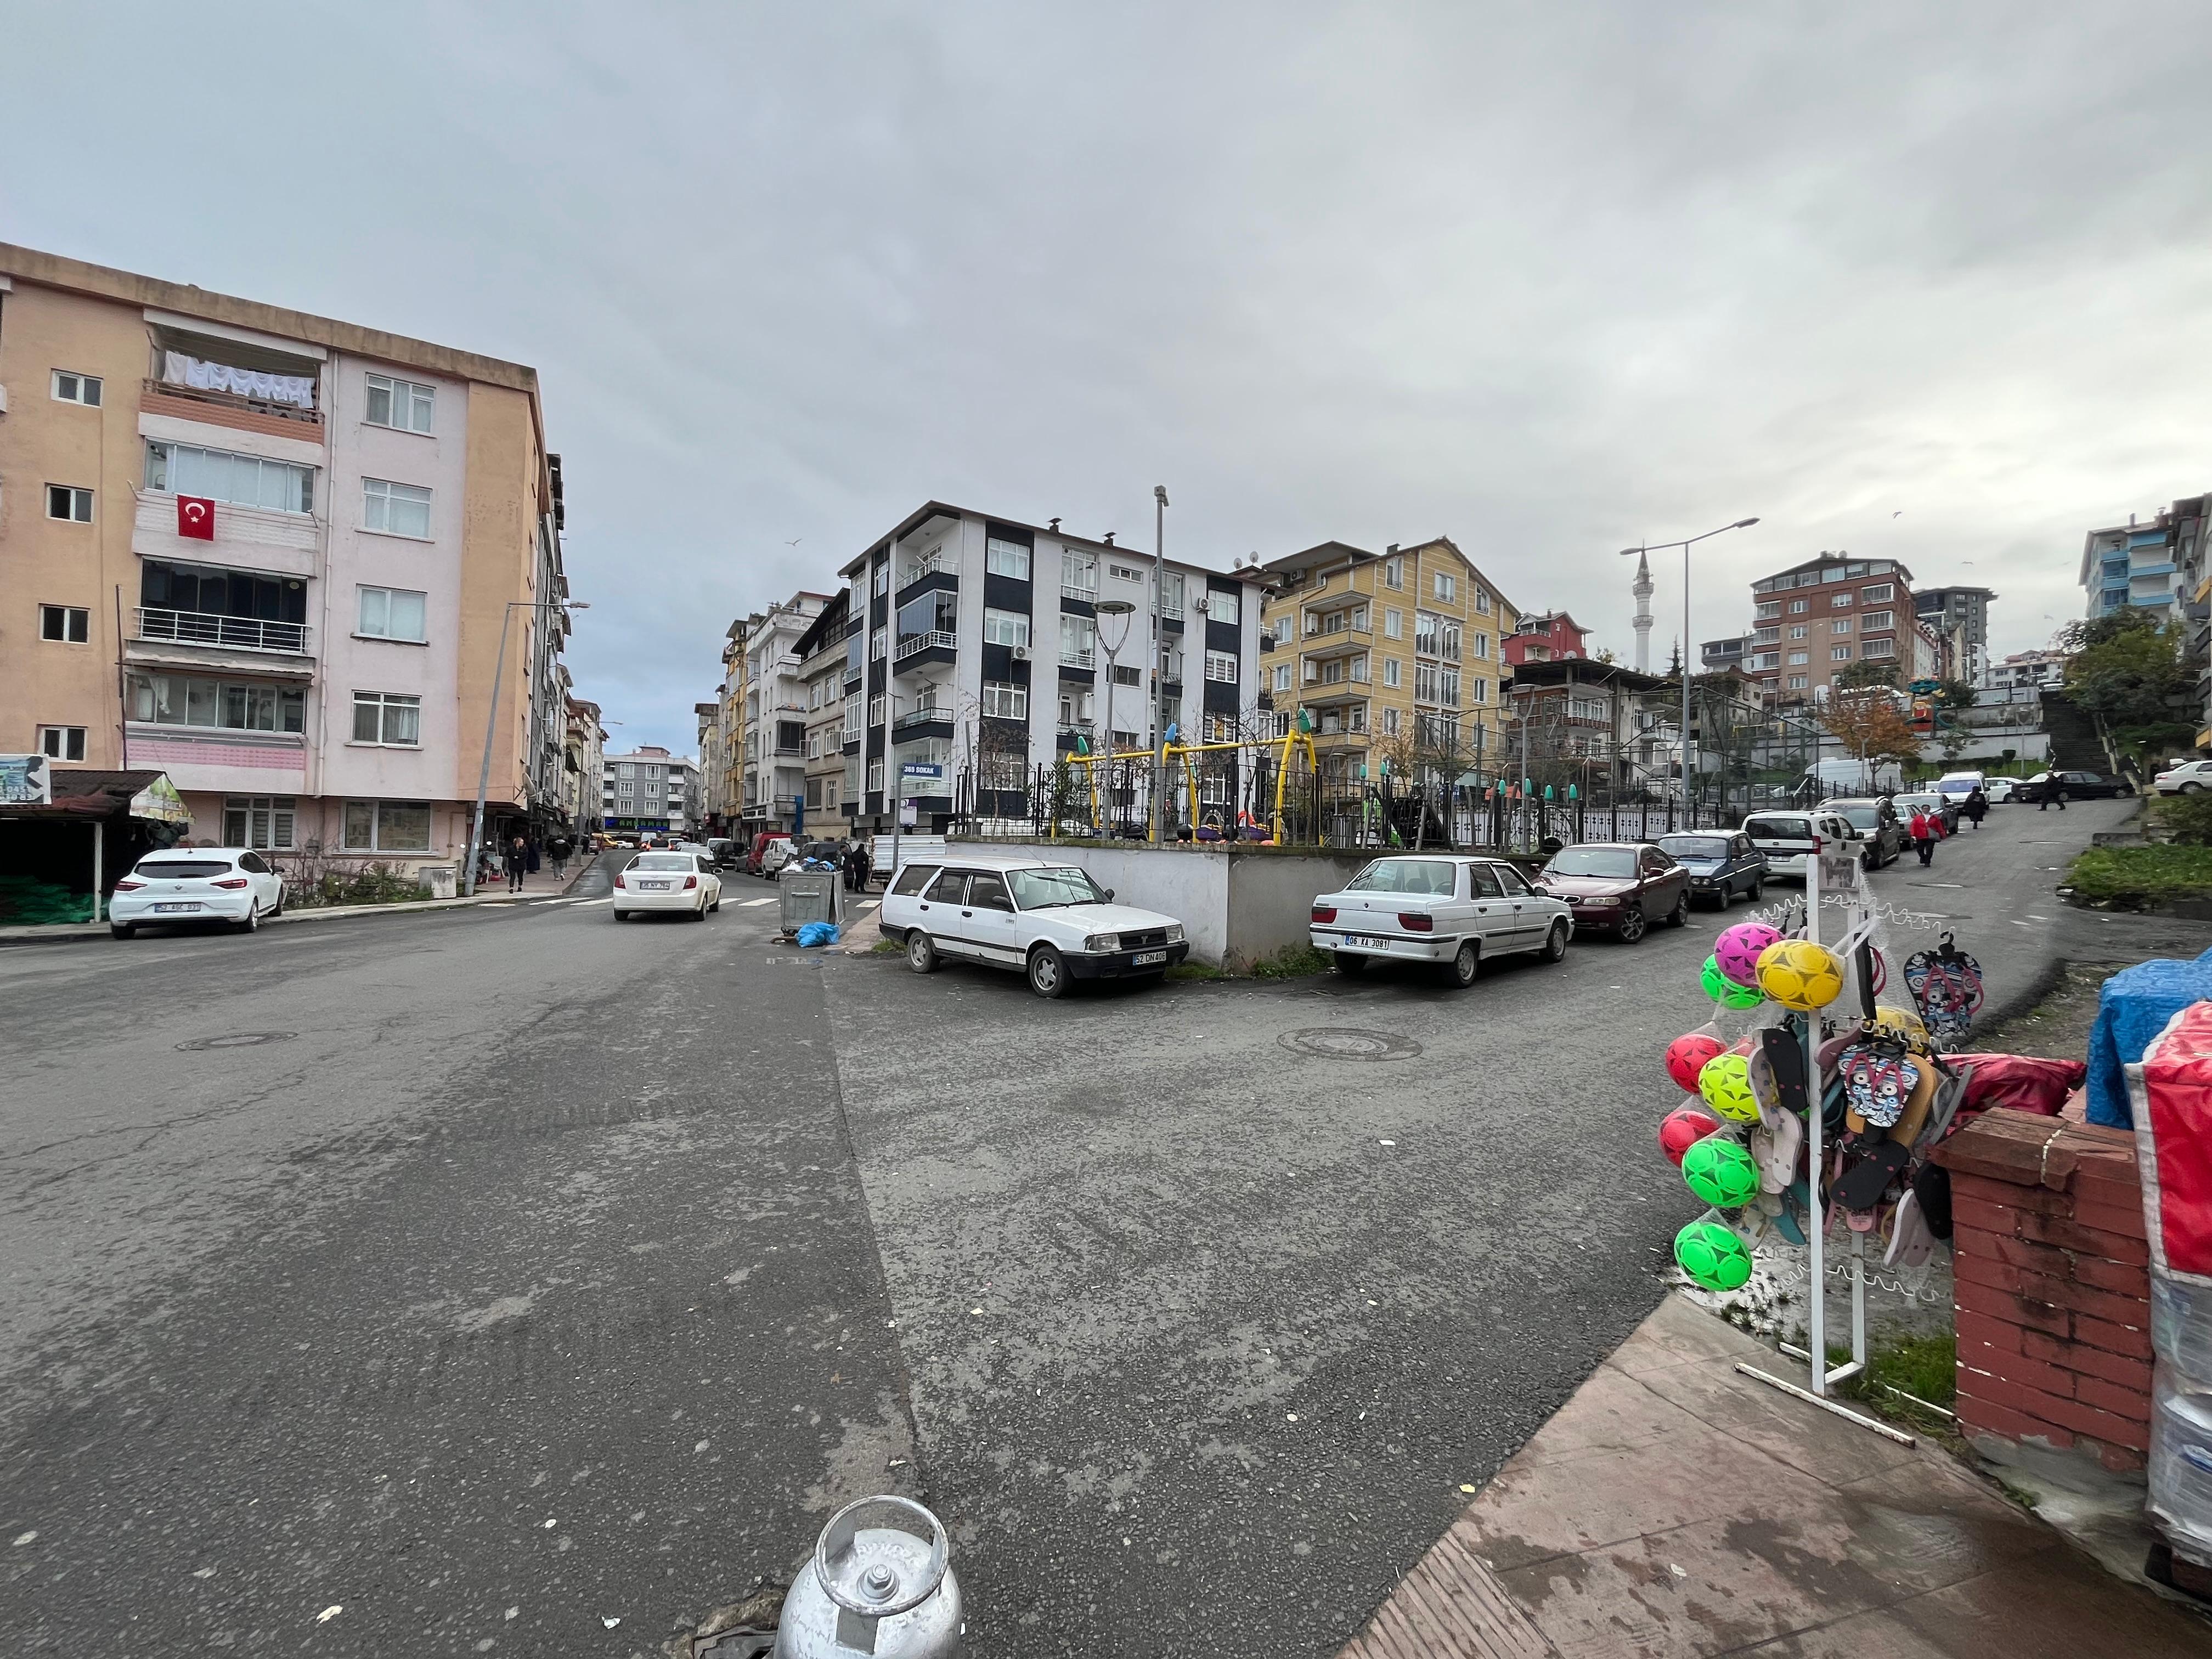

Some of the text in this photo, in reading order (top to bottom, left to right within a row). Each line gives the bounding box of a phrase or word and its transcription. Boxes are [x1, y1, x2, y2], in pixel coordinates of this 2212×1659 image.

[1350, 936, 1358, 945] 06
[1136, 955, 1143, 963] 52
[1146, 953, 1155, 962] DN
